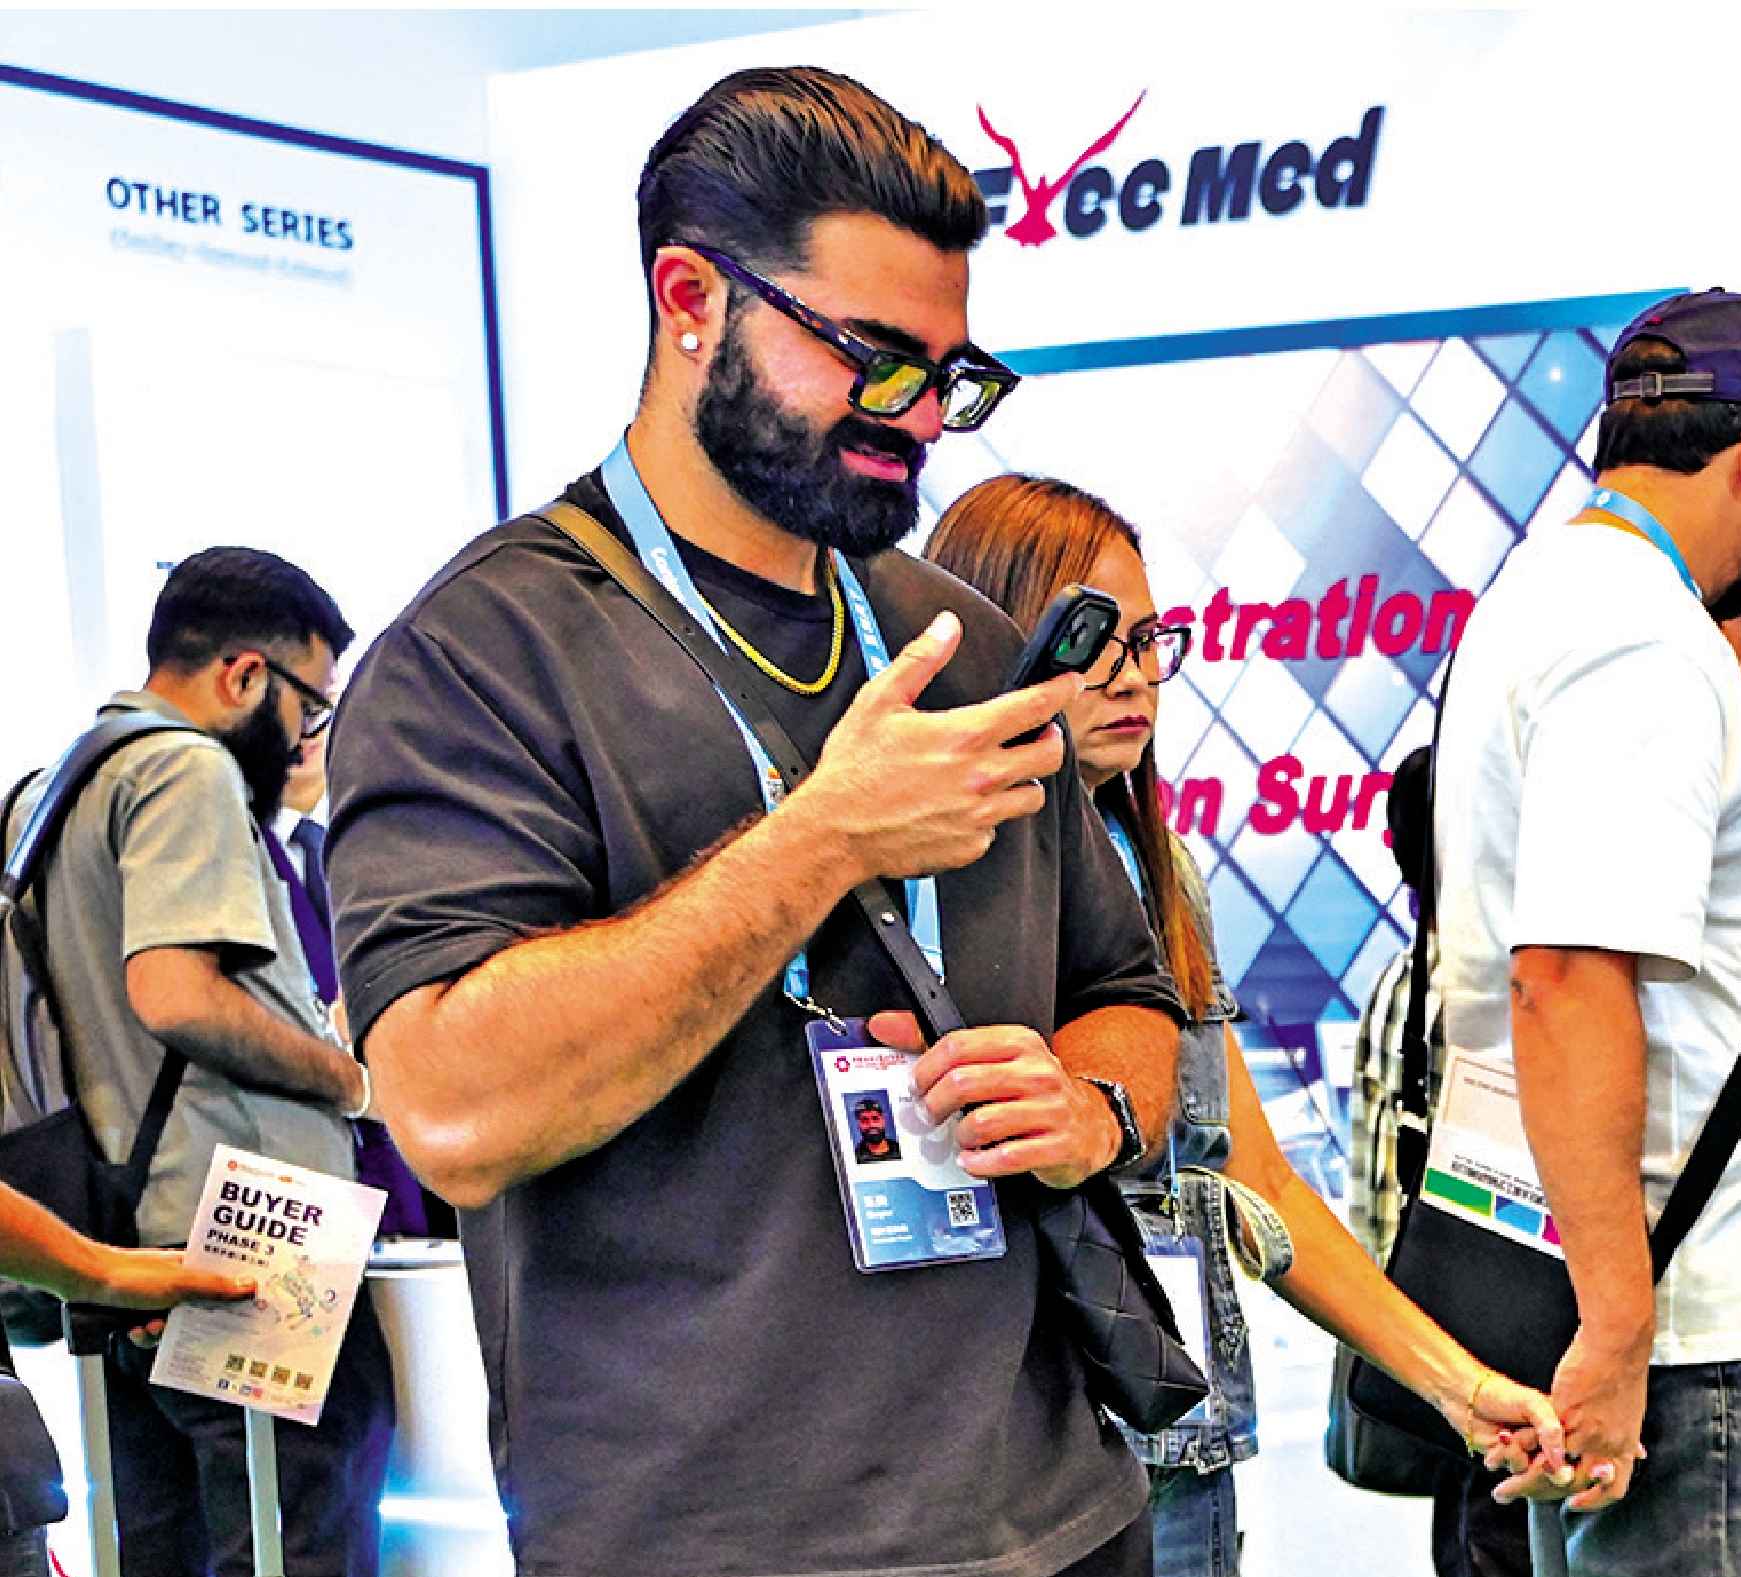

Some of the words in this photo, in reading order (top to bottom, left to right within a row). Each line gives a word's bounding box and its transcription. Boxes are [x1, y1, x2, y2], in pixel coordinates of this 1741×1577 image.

[106, 177, 222, 226] OTHER
[240, 202, 355, 250] SERIES
[1159, 574, 1477, 663] stration
[1249, 754, 1395, 850] Sur
[213, 1204, 309, 1247] GUIDE
[220, 1180, 324, 1226] BUYER
[206, 1227, 261, 1249] PHASE
